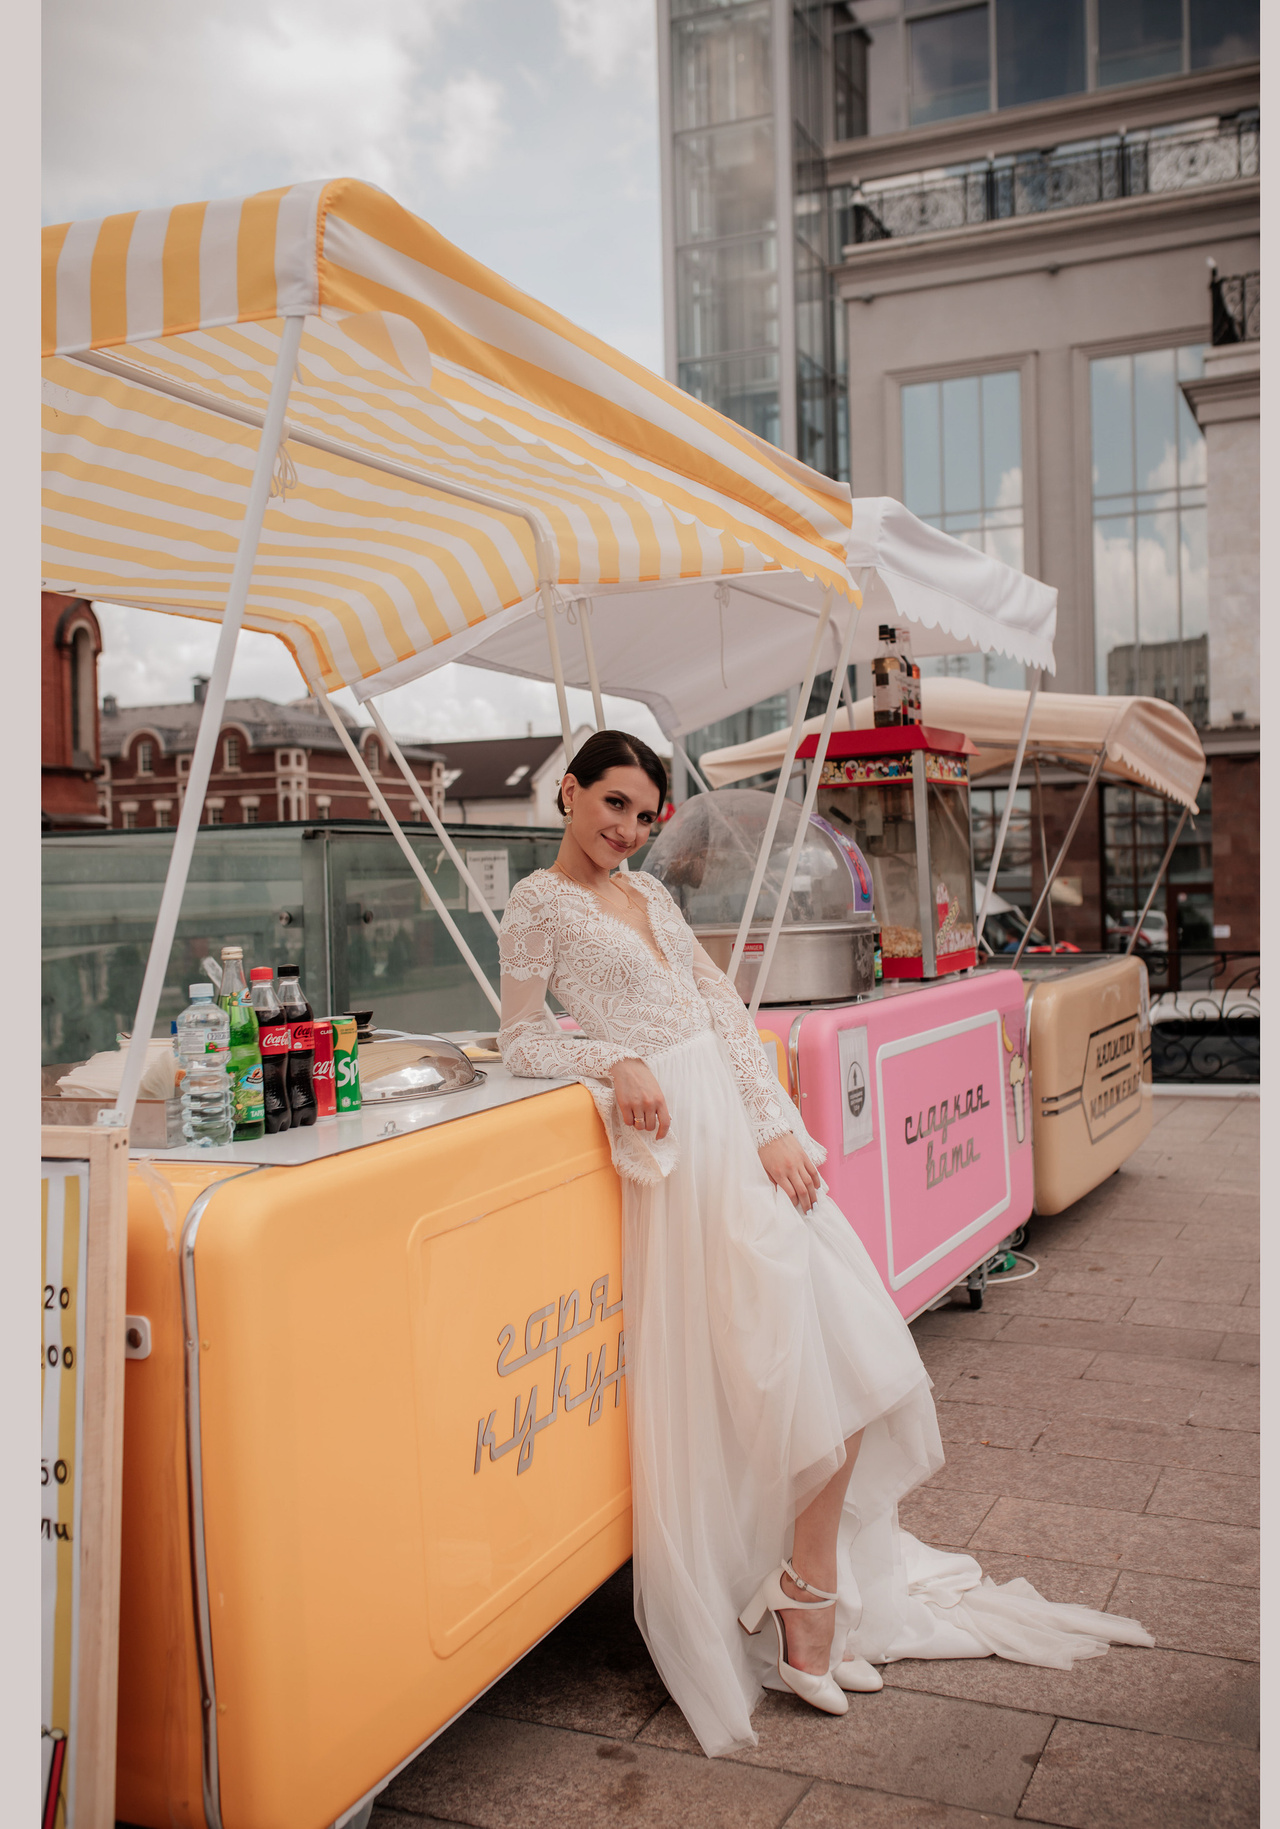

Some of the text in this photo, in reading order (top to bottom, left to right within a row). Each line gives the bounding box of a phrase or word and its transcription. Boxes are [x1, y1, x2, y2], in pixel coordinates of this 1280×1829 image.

[337, 1056, 360, 1088] Sp
[904, 1084, 990, 1145] сладкая
[926, 1136, 981, 1190] вата
[497, 1273, 623, 1383] горя
[41, 1518, 71, 1541] ли
